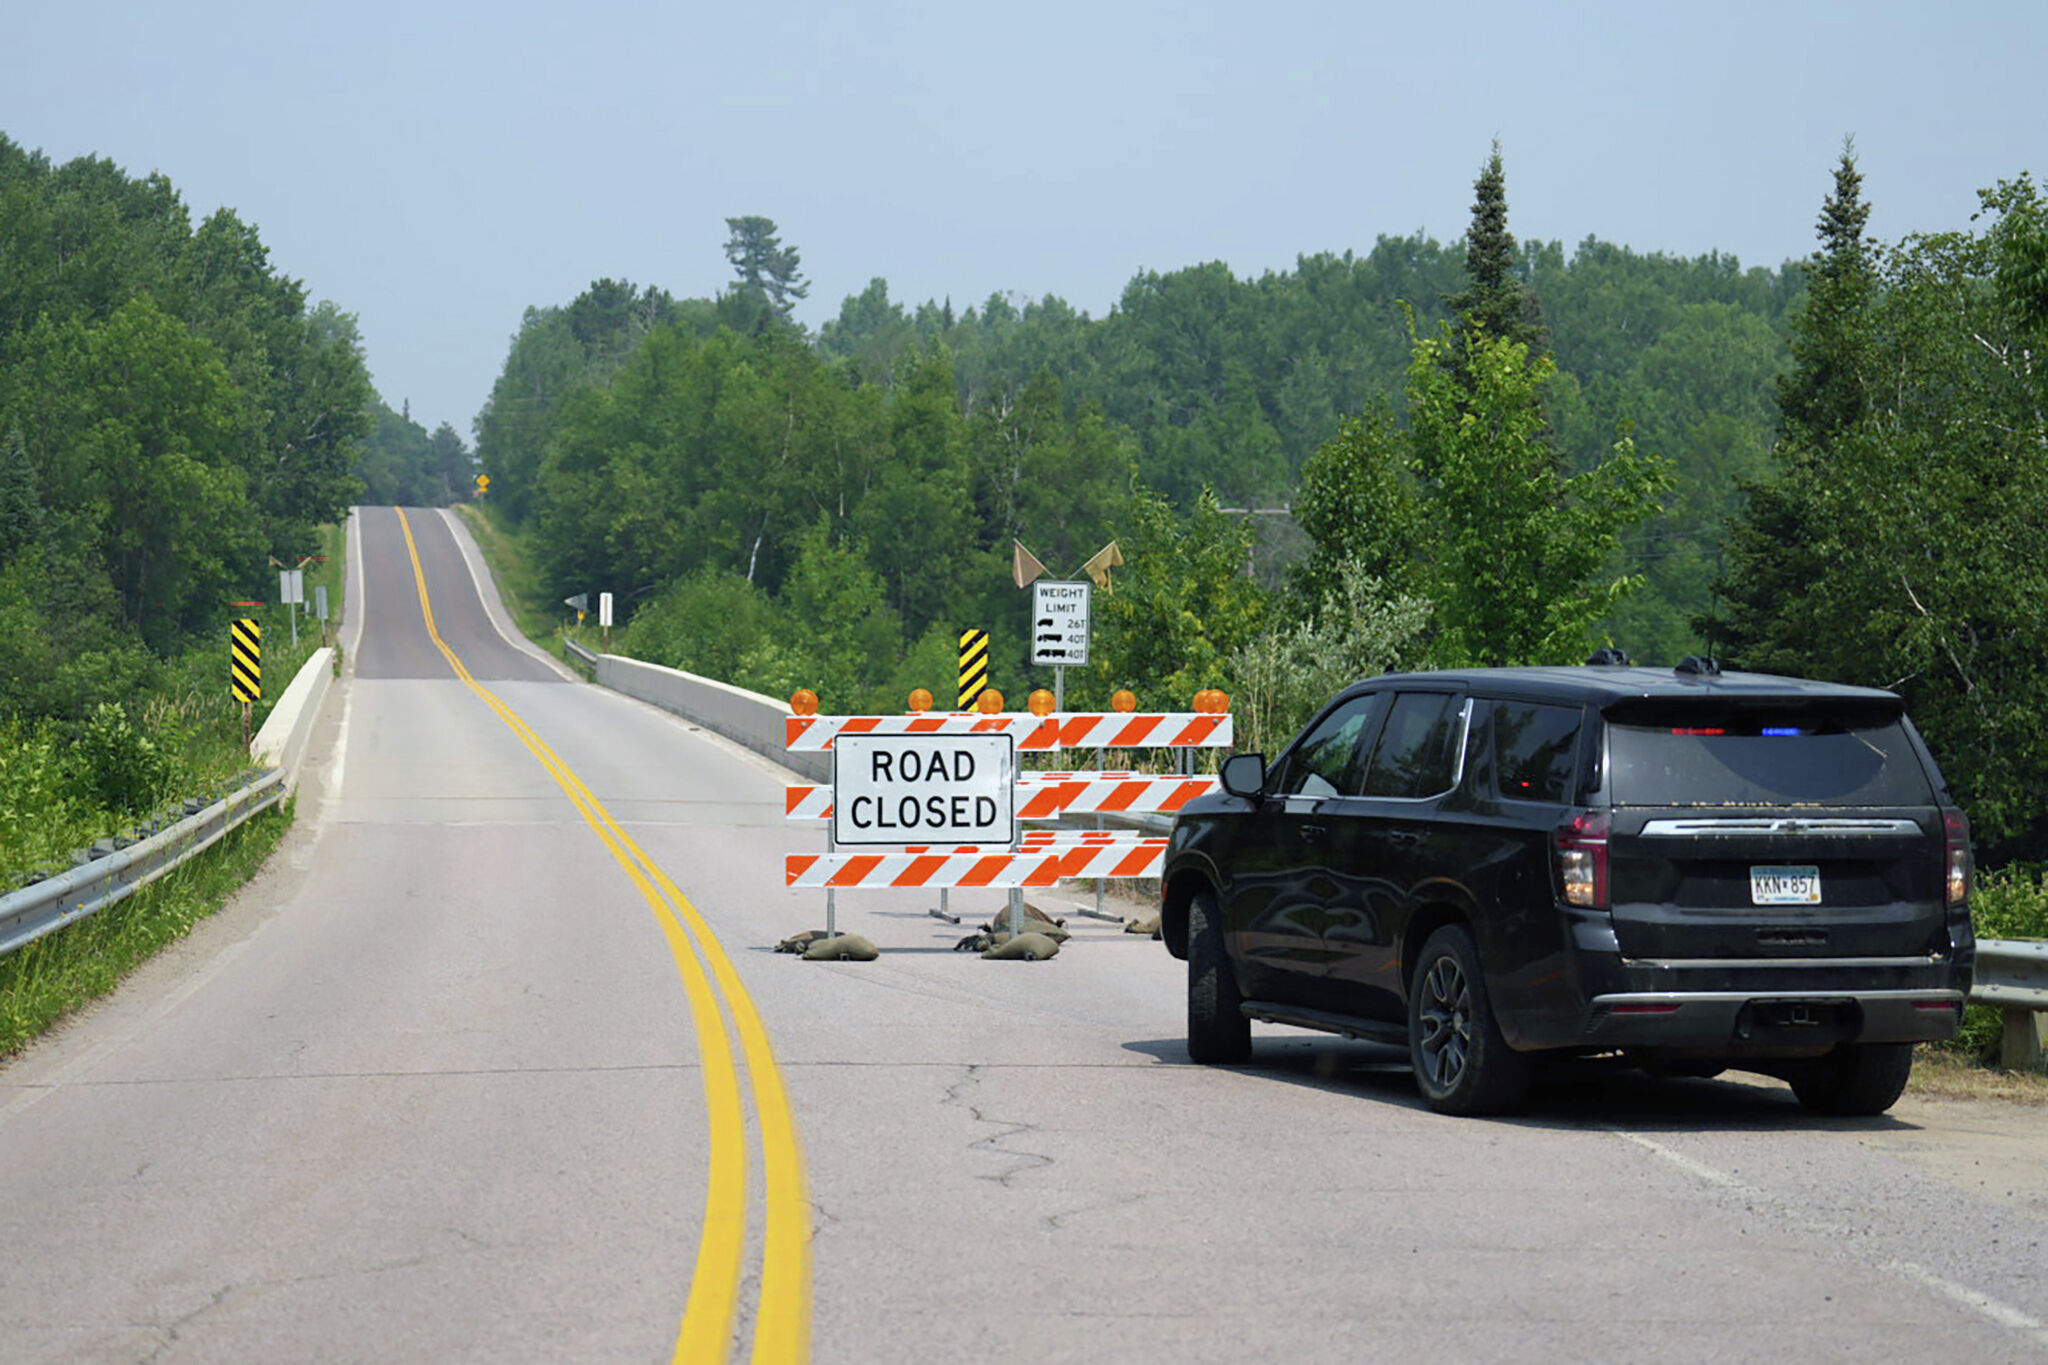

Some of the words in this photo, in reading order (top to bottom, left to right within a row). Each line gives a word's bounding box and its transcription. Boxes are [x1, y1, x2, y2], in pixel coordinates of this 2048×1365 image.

[1040, 588, 1084, 598] WEIGHT
[1046, 604, 1077, 613] LIMIT
[1067, 619, 1085, 629] 26T
[1067, 634, 1085, 644] 40T
[1067, 649, 1084, 659] 40T
[872, 750, 975, 782] ROAD
[851, 796, 997, 829] CLOSED
